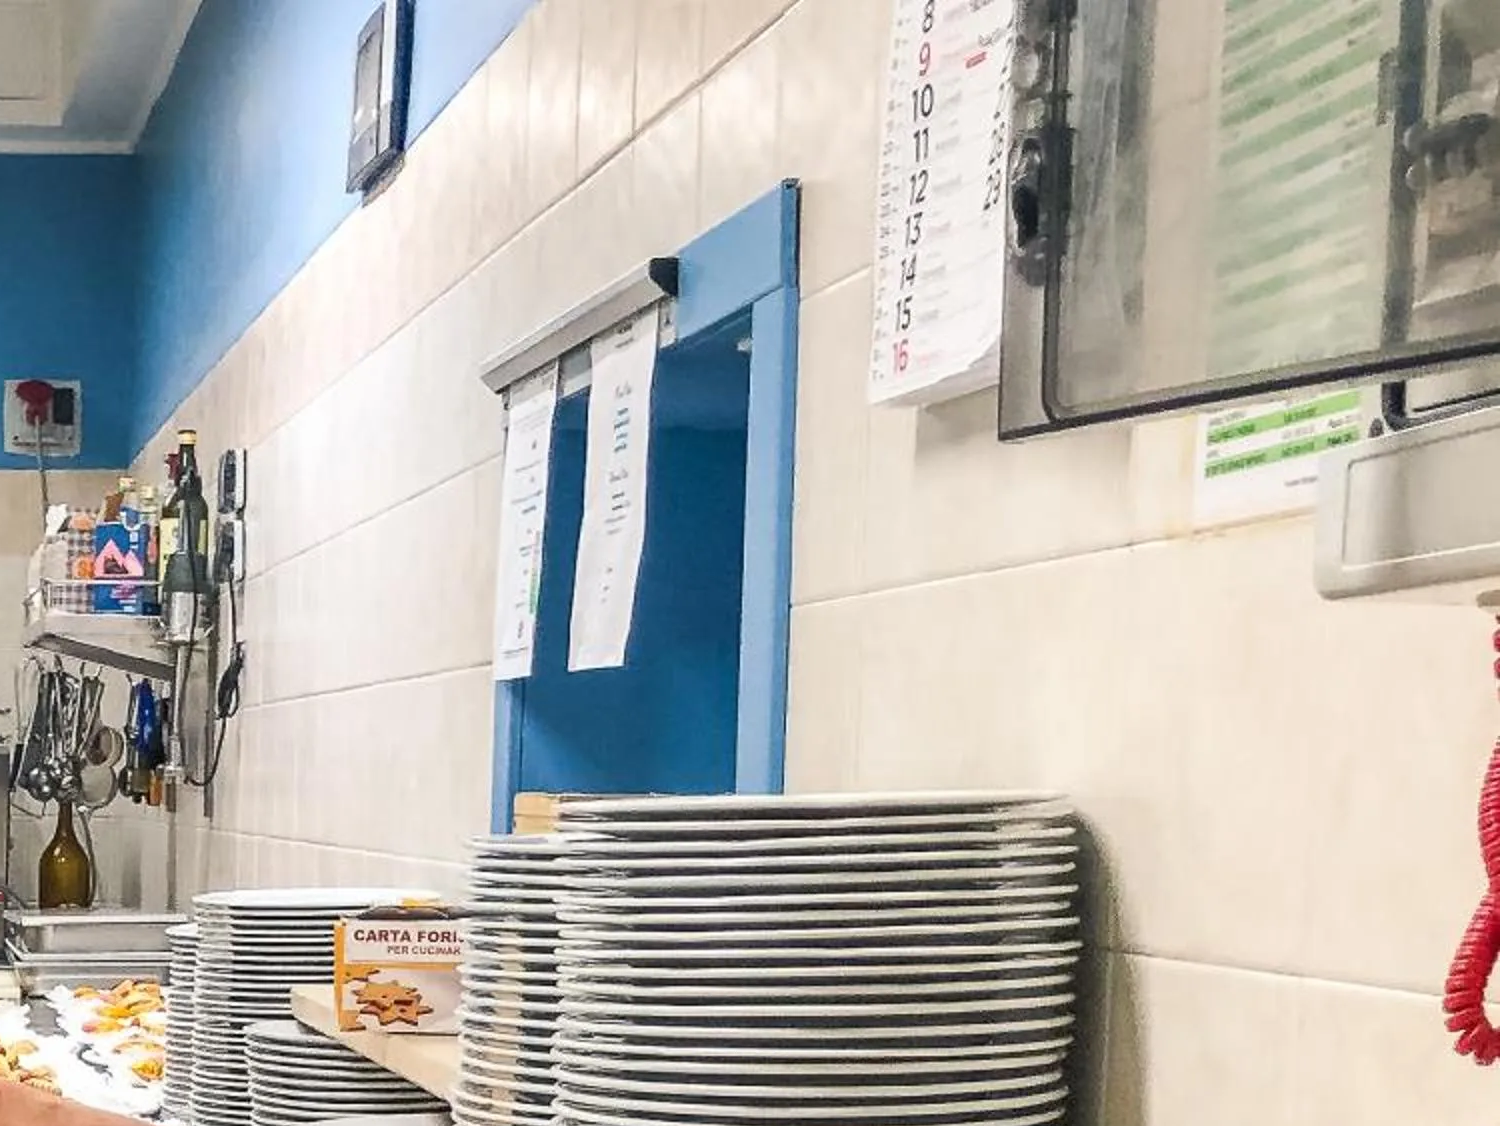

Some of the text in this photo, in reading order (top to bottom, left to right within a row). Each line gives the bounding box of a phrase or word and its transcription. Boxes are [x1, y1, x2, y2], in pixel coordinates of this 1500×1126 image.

[922, 0, 935, 33] 8
[919, 41, 931, 77] 9
[912, 83, 934, 122] 10
[913, 127, 929, 163] 11
[909, 169, 929, 206] 12
[905, 211, 923, 249] 13
[900, 252, 917, 290] 14
[896, 294, 913, 332] 15
[893, 338, 909, 374] 16
[353, 929, 411, 943] CARTA
[387, 945, 461, 956] PER CUCINAR
